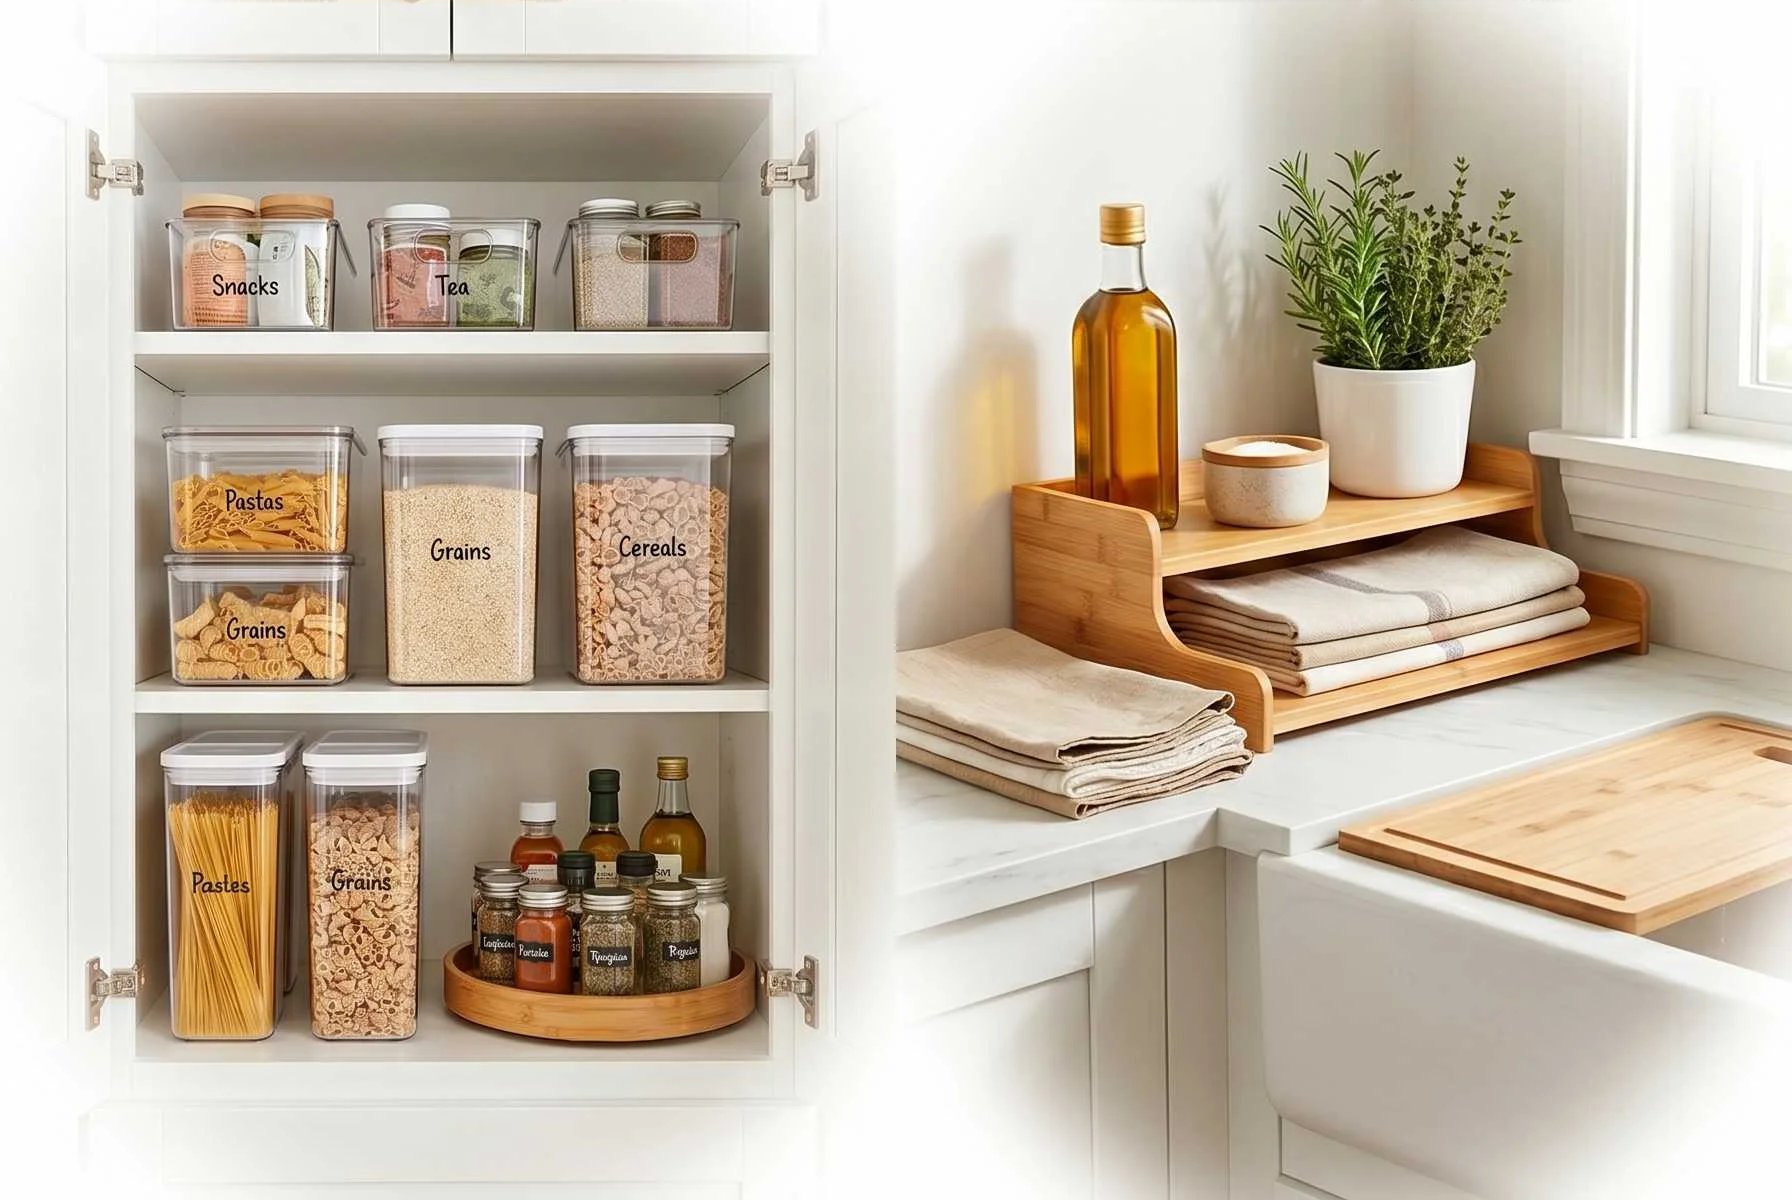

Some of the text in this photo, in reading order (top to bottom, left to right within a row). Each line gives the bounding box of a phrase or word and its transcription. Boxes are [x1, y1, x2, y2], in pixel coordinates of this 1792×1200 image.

[212, 273, 279, 297] Snacks
[435, 274, 470, 296] Tea
[225, 488, 285, 511] Pastas
[429, 537, 492, 562] Grains
[619, 535, 687, 559] Cereals
[225, 618, 287, 642] Grains
[192, 871, 250, 894] Pastes
[331, 868, 392, 892] Grains
